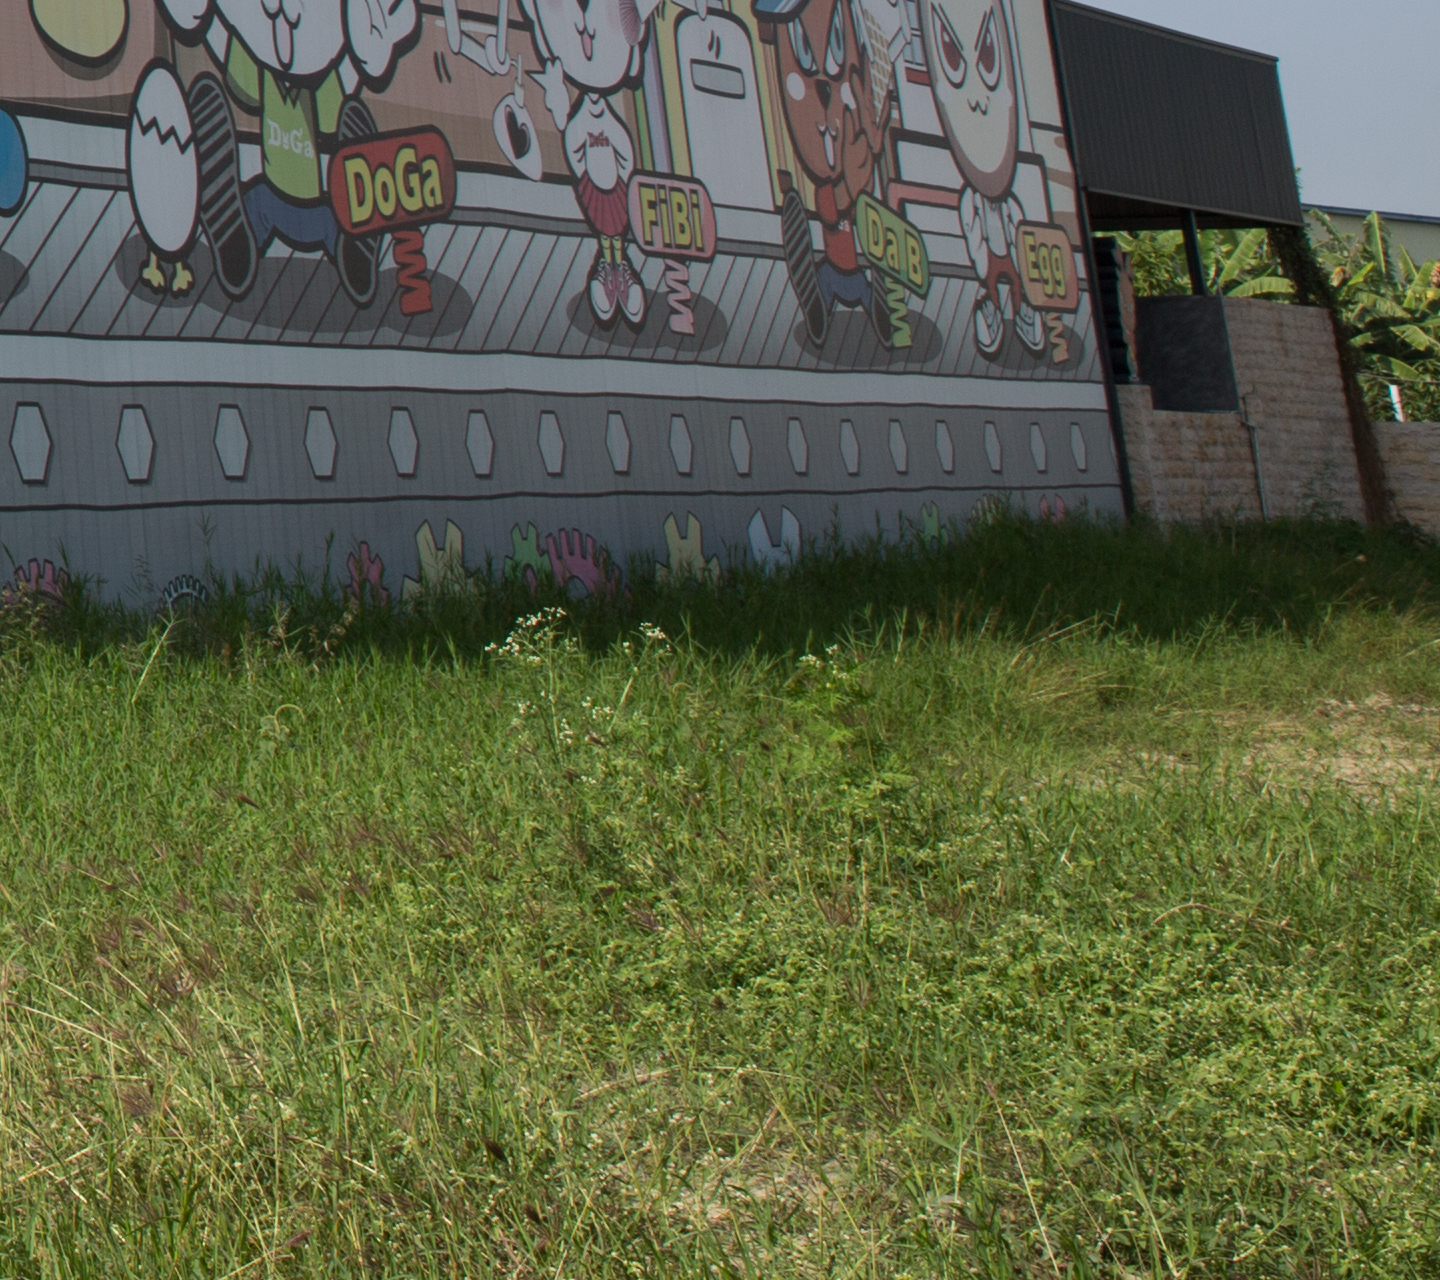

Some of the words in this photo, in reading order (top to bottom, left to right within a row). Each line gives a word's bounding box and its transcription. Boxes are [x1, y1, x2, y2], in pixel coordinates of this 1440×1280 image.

[343, 143, 444, 229] DoGa
[637, 182, 705, 253] FiBi
[1022, 231, 1068, 299] Egg
